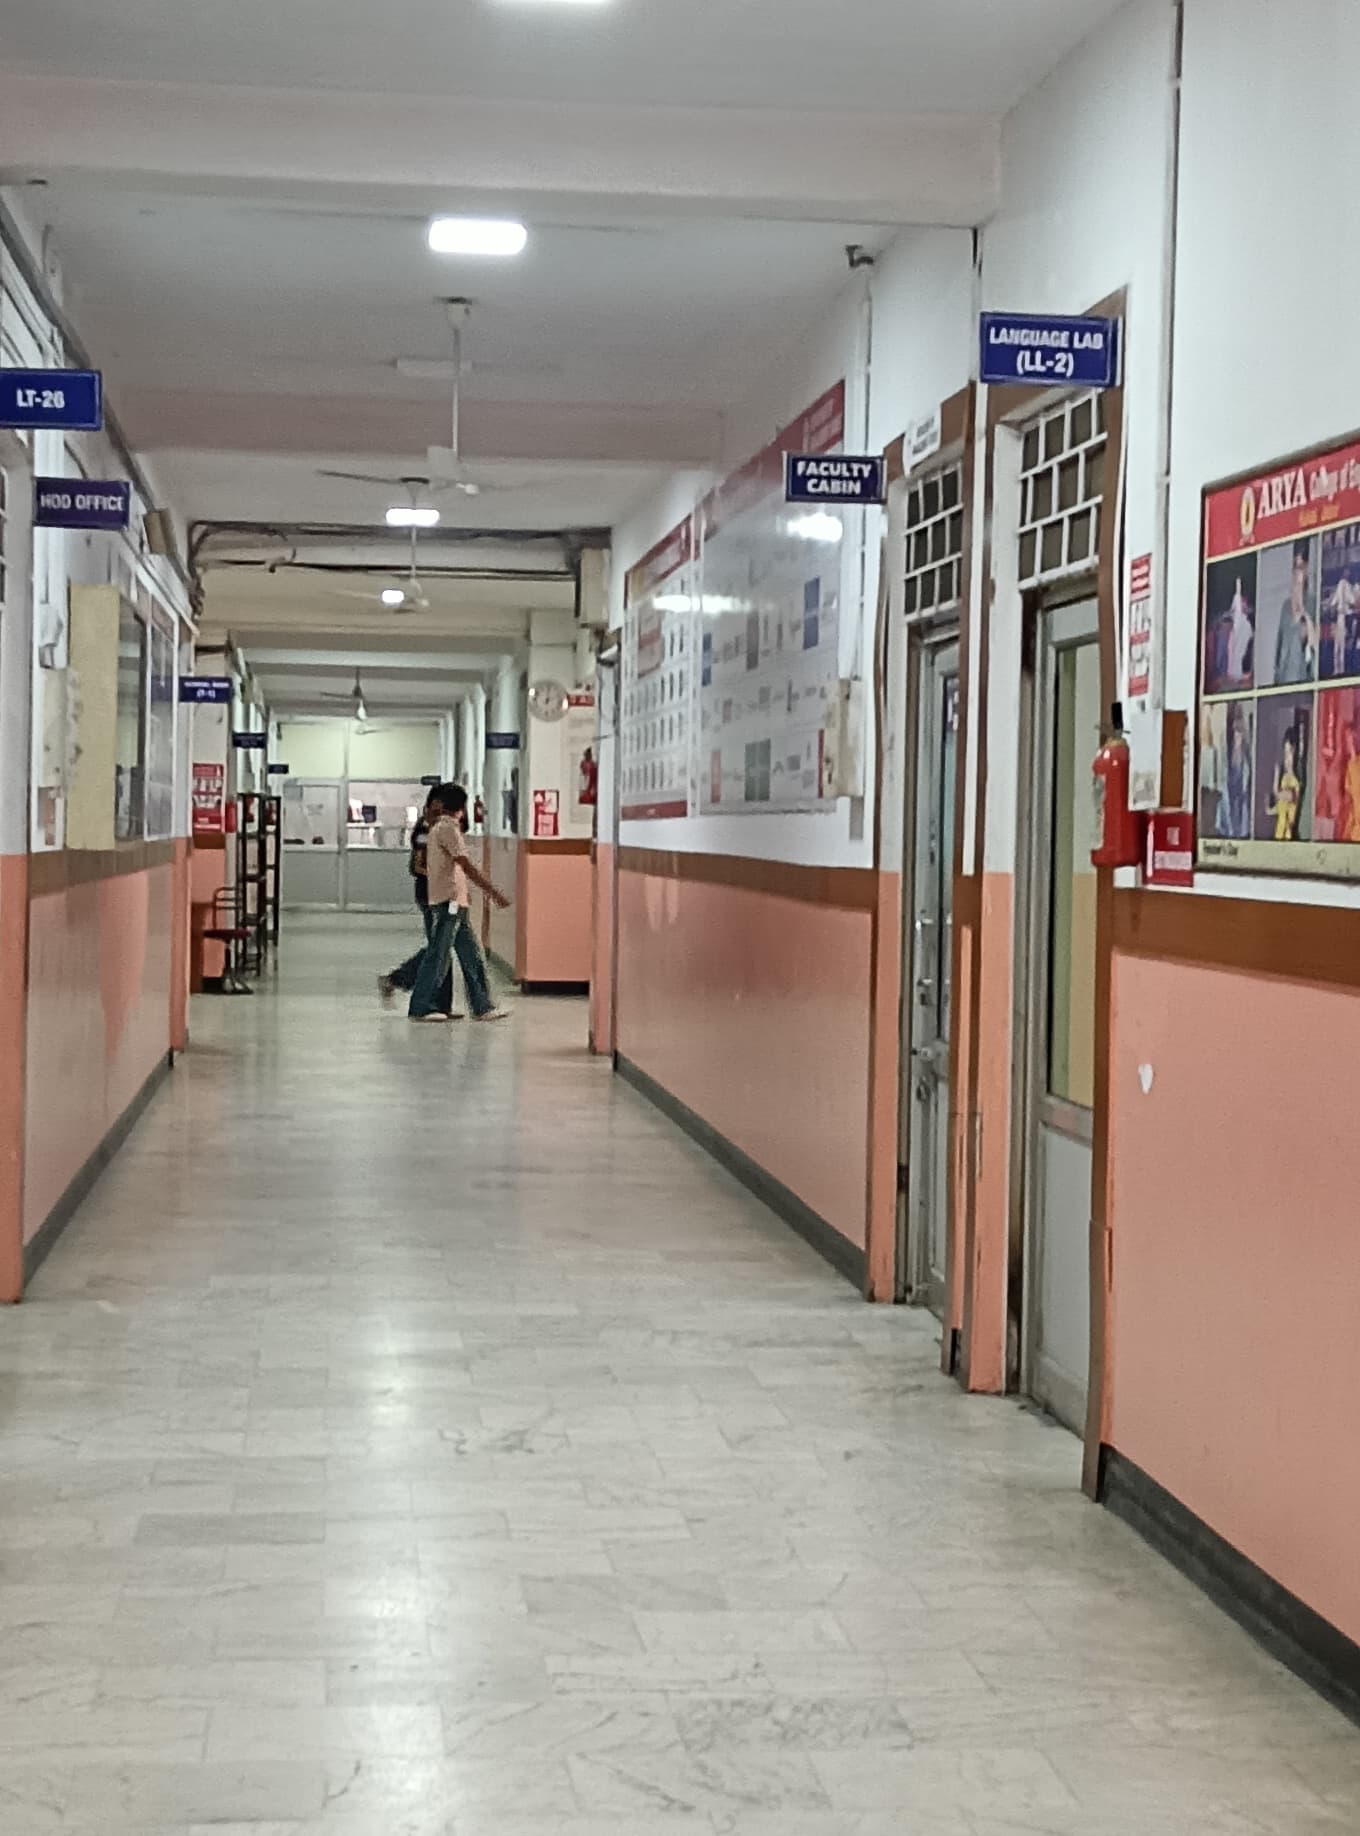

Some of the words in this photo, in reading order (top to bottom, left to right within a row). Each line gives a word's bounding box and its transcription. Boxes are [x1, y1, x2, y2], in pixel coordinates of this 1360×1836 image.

[989, 326, 1070, 349] LANGUAGE
[1073, 331, 1104, 350] LAB
[1016, 350, 1075, 378] (LL-2)
[797, 461, 872, 478] FACULTY
[807, 478, 861, 495] CABIN
[1257, 467, 1307, 520] ARYA
[41, 494, 71, 510] HOD
[75, 495, 126, 512] OFFICE
